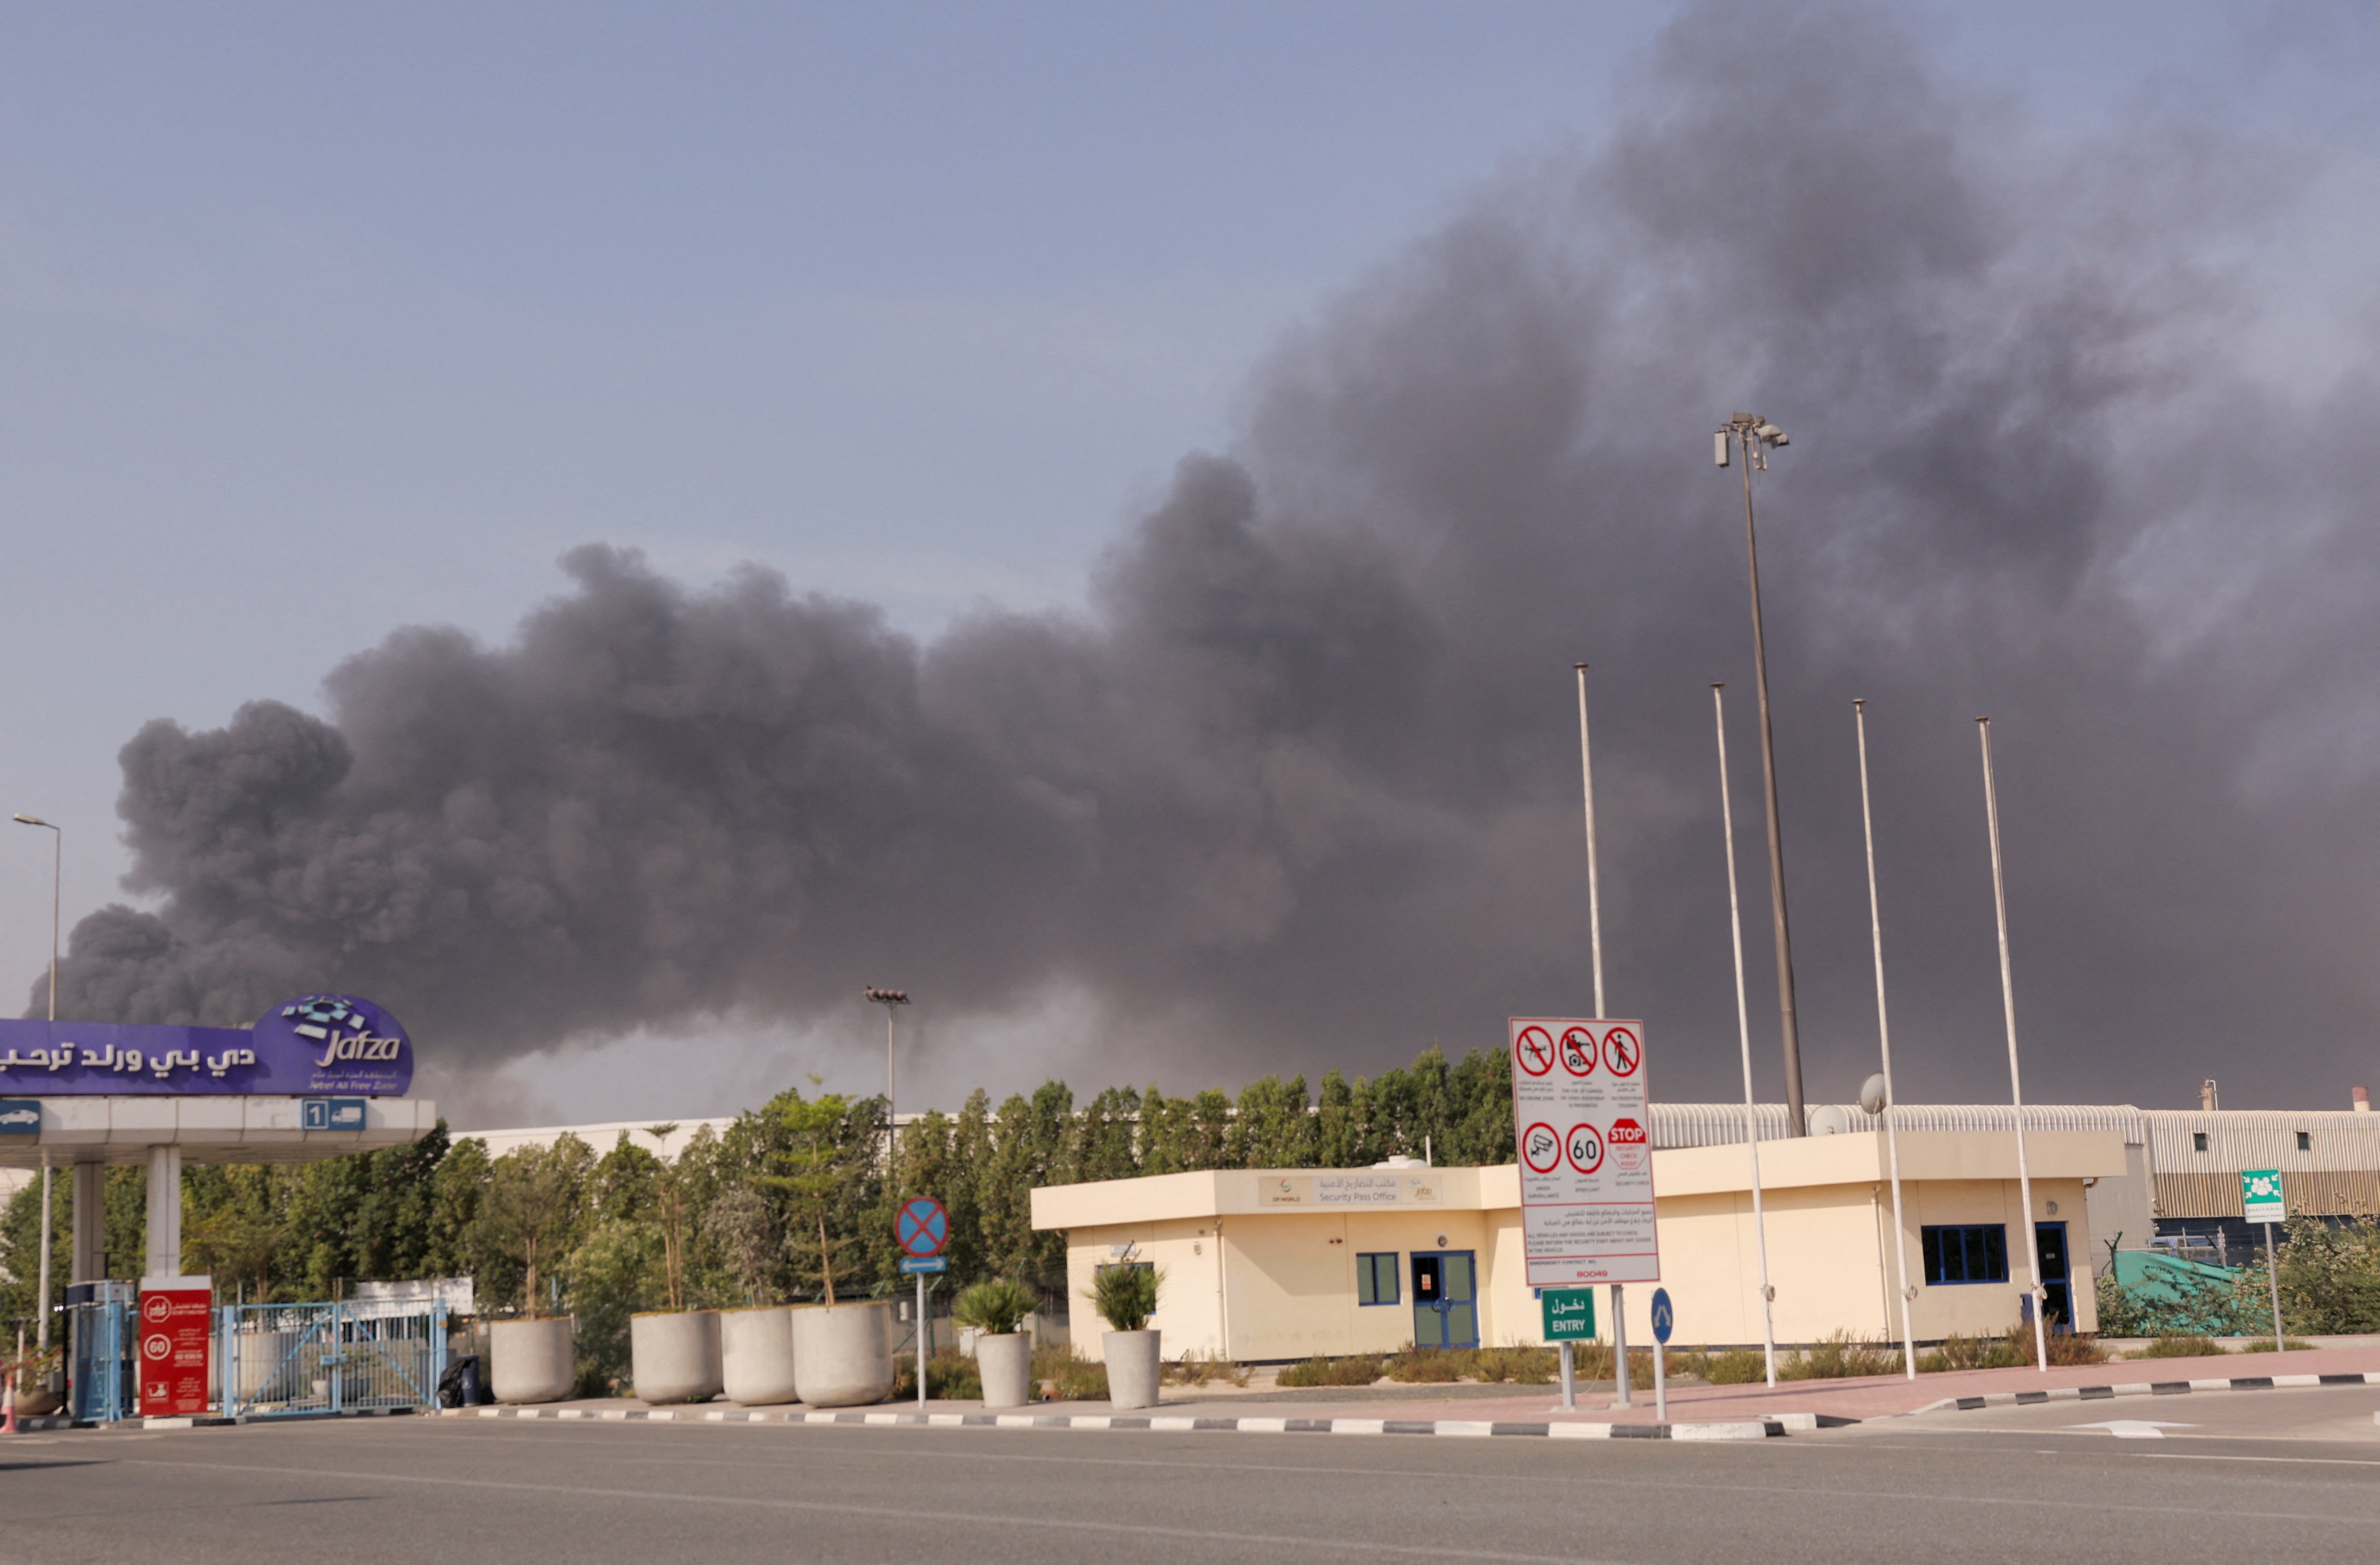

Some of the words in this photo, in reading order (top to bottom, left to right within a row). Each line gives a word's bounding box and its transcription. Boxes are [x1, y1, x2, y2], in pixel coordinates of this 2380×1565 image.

[81, 1044, 142, 1072] ورلد
[150, 1049, 199, 1078] بي
[207, 1049, 255, 1077] دي
[309, 1081, 335, 1090] Jebel
[336, 1081, 348, 1089] Ali
[350, 1081, 372, 1089] Free
[373, 1081, 397, 1089] Zone
[309, 1106, 320, 1125] 1
[1611, 1127, 1642, 1141] STOP
[1573, 1140, 1597, 1160] 60
[1319, 1177, 1344, 1187] الأمنية
[1345, 1178, 1374, 1190] التصاريح
[1375, 1178, 1396, 1187] مكتب
[1319, 1192, 1351, 1202] Security
[1354, 1193, 1371, 1201] Pass
[1373, 1192, 1397, 1201] Office
[1551, 1298, 1585, 1314] دخول
[1552, 1319, 1585, 1332] ENTRY
